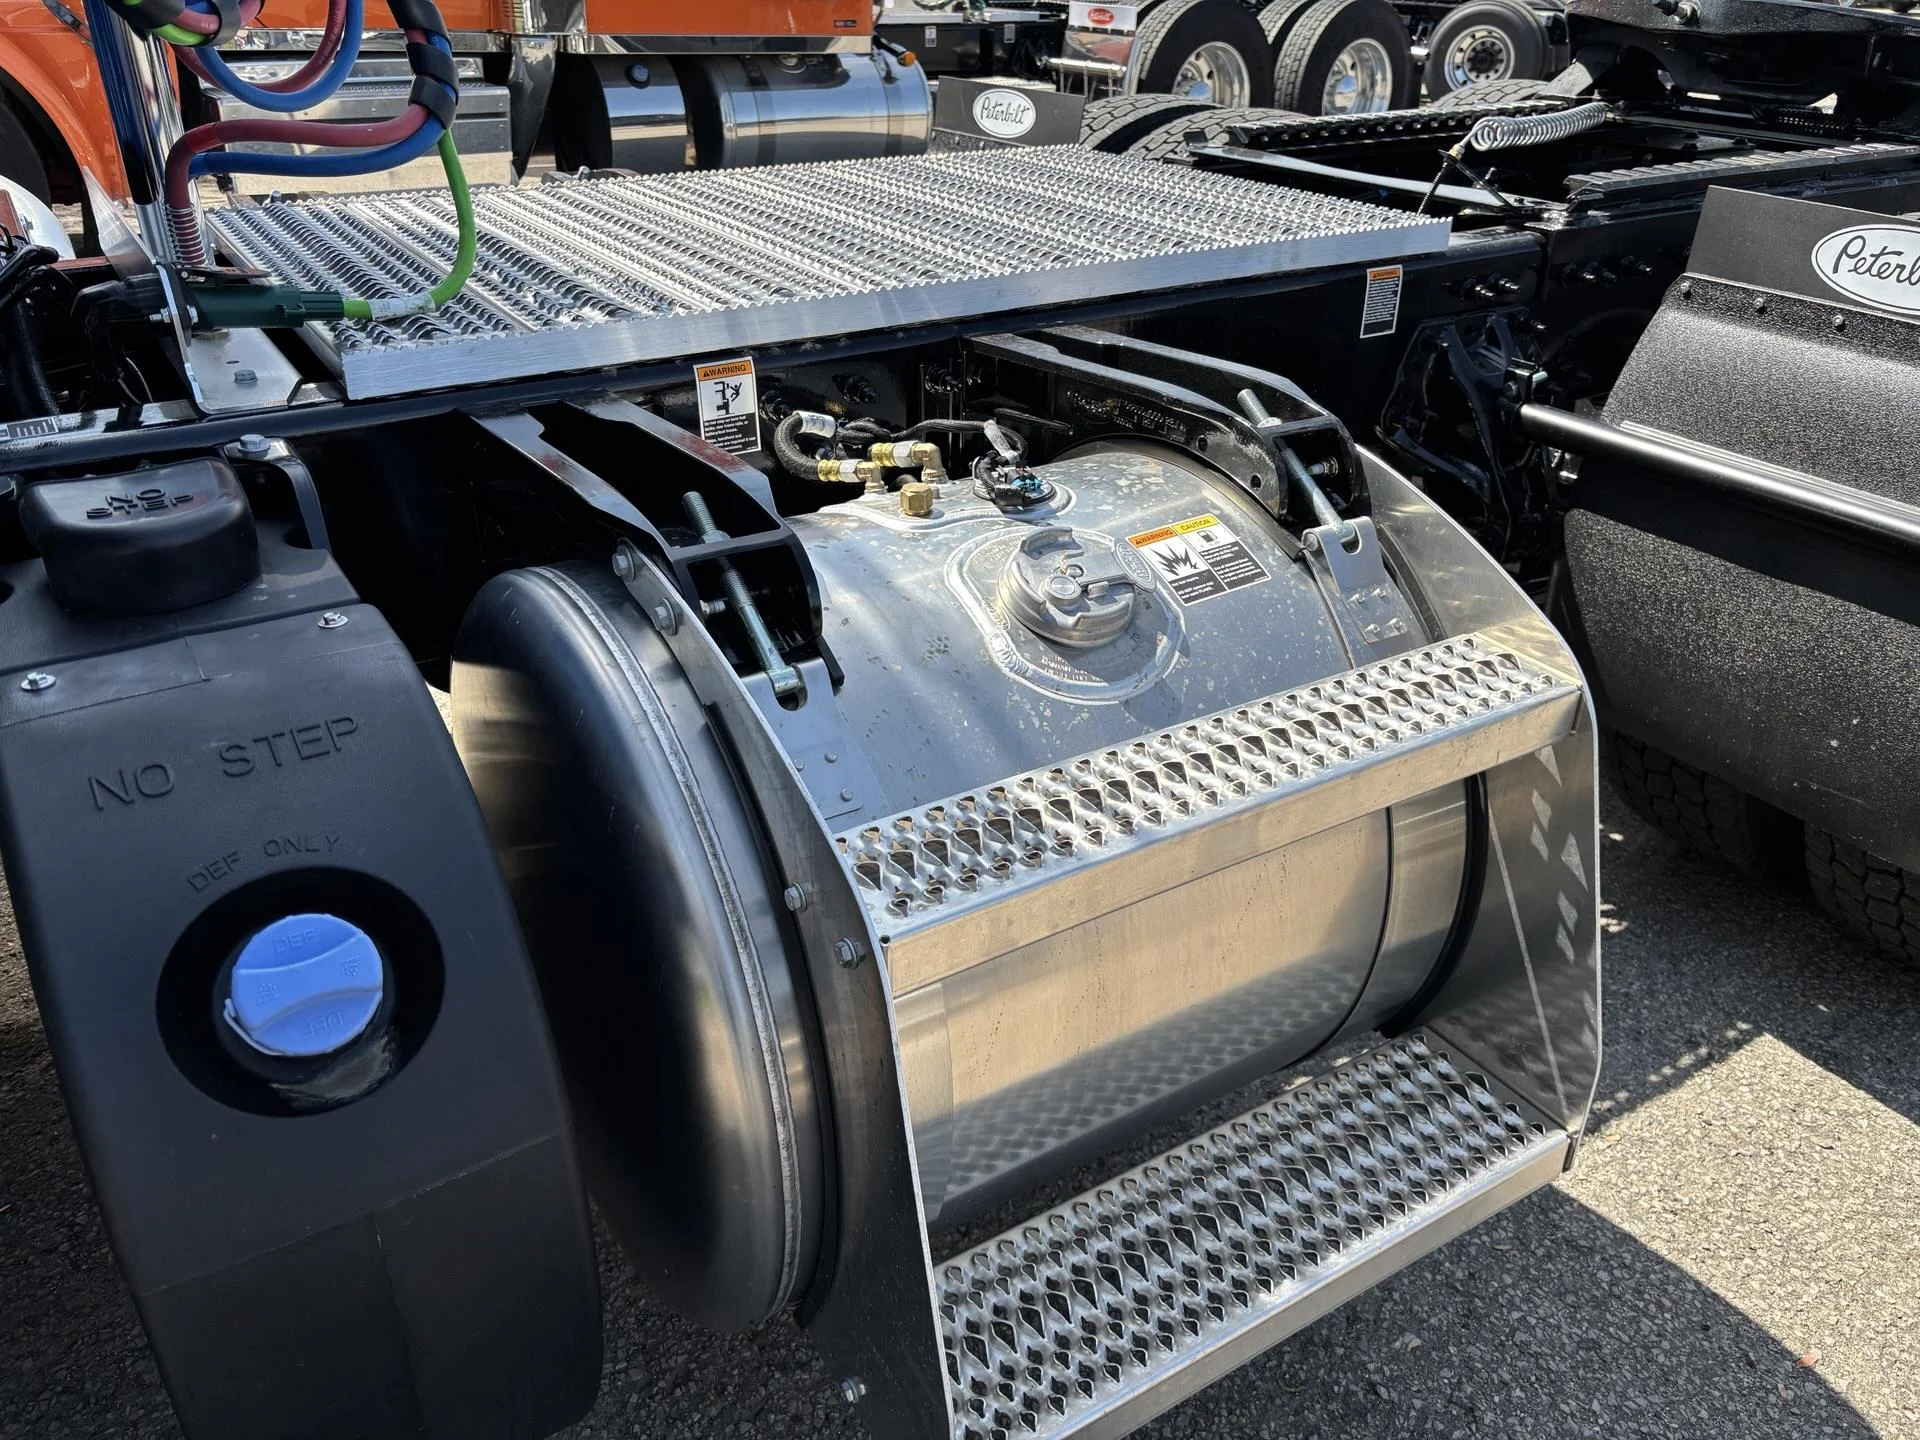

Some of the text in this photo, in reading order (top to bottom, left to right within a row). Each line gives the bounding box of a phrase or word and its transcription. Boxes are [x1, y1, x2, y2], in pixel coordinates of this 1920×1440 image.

[981, 96, 1030, 124] Peterbilt
[708, 364, 747, 377] WARNING
[86, 494, 194, 519] STEP
[105, 488, 166, 506] NO
[1139, 529, 1174, 544] WARNING
[1180, 518, 1212, 531] CAUTION
[88, 716, 359, 813] NO STEP
[187, 835, 341, 893] DEF ONLY
[273, 928, 317, 953] DEF
